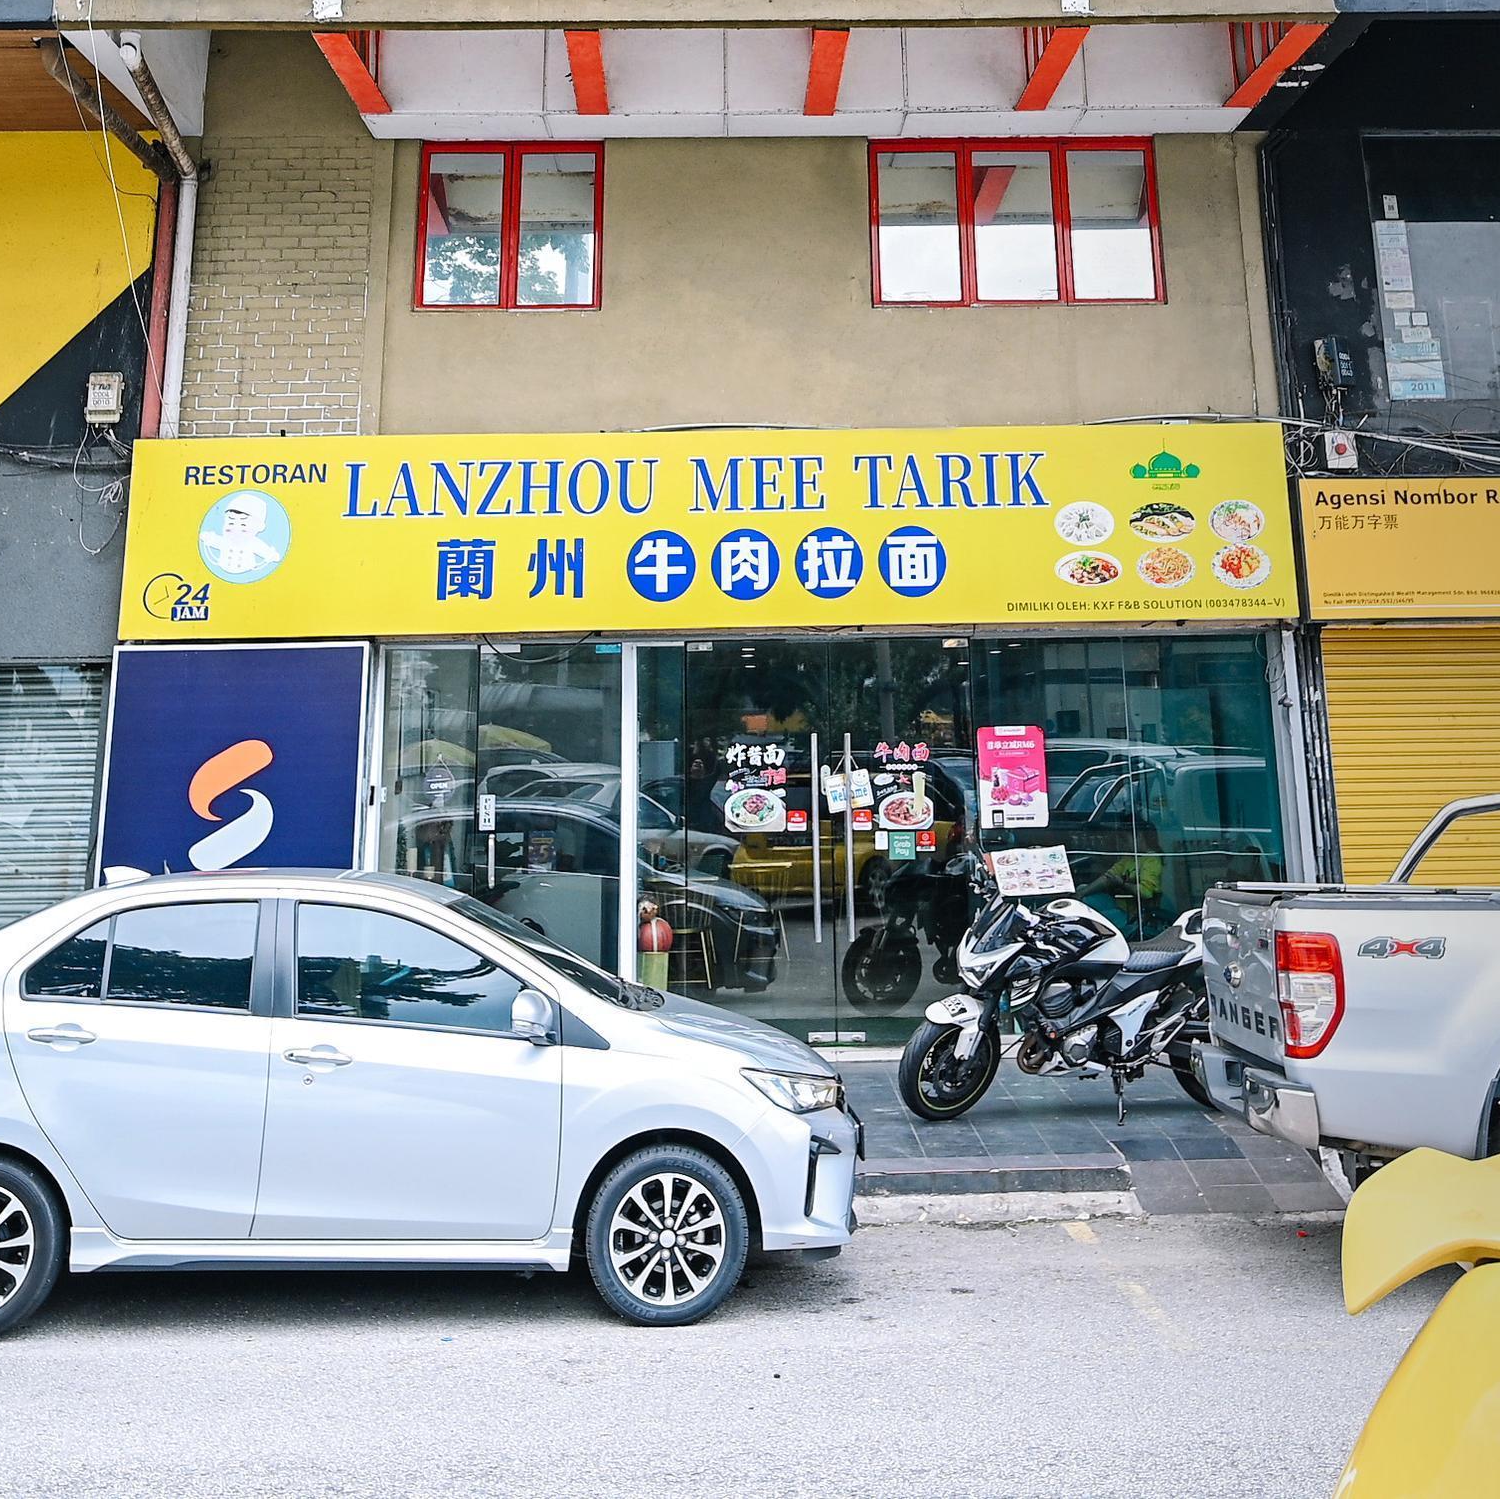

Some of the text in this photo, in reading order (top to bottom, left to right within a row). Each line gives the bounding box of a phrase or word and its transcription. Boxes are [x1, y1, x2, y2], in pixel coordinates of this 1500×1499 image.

[1411, 382, 1436, 391] 2011
[184, 462, 328, 486] RESTORAN
[341, 451, 1051, 519] LANZHOU MEE TARIK
[1315, 489, 1386, 510] Agensi
[1394, 488, 1478, 505] Nombor
[1318, 514, 1399, 531] 万能万字票
[174, 583, 210, 605] 24
[173, 606, 209, 621] JAM
[1007, 601, 1055, 612] DIMILIKI
[1056, 600, 1091, 612] OLEH:
[1092, 600, 1115, 611] KXF
[1117, 600, 1141, 610] F&B
[1143, 598, 1203, 610] SOLUTION
[873, 740, 930, 764] 牛肉面
[430, 782, 449, 790] OPEN
[829, 786, 869, 803] Welome
[483, 797, 492, 824] PUSH
[893, 840, 911, 849] Grab
[895, 848, 909, 857] Pay
[1210, 992, 1283, 1043] RANGER
